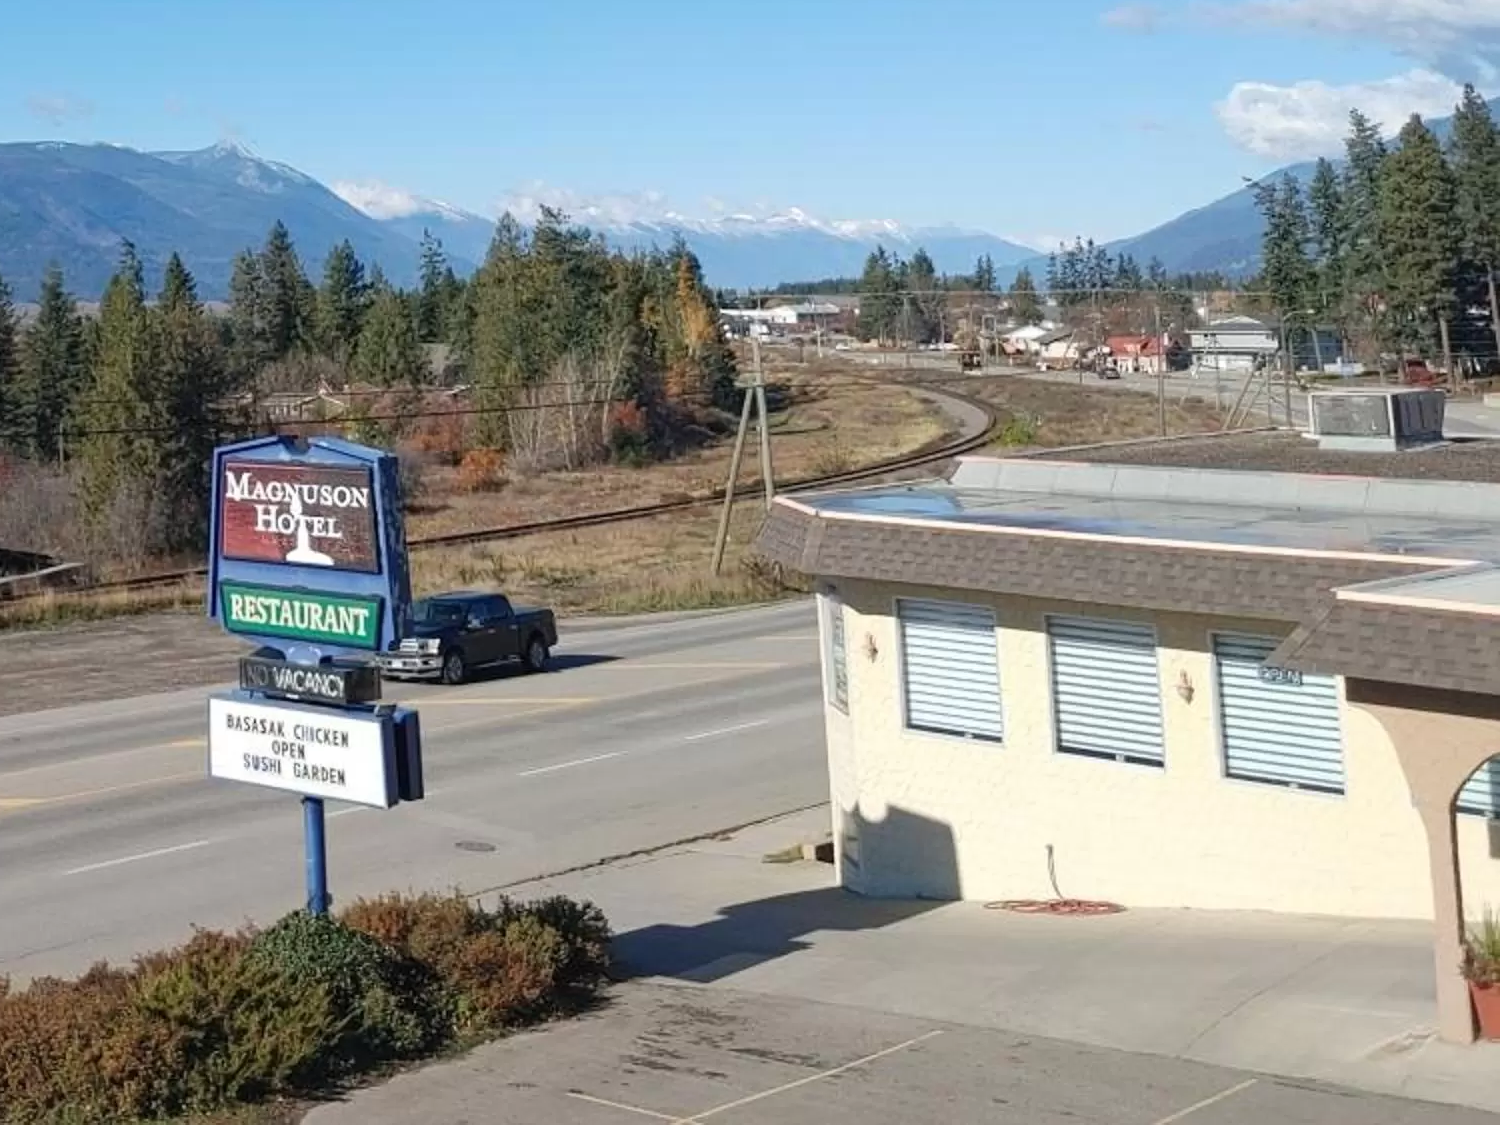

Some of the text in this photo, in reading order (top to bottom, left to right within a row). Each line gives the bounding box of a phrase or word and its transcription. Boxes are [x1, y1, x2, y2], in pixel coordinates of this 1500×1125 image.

[225, 471, 369, 507] MAGNUSON
[254, 504, 343, 538] HOTEL
[230, 593, 369, 636] RESTAURANT
[272, 666, 344, 697] VACANCY
[226, 714, 349, 747] BASASAK CHICKEN
[271, 740, 305, 759] OPEN
[243, 753, 346, 785] SUSHI GARDEN
